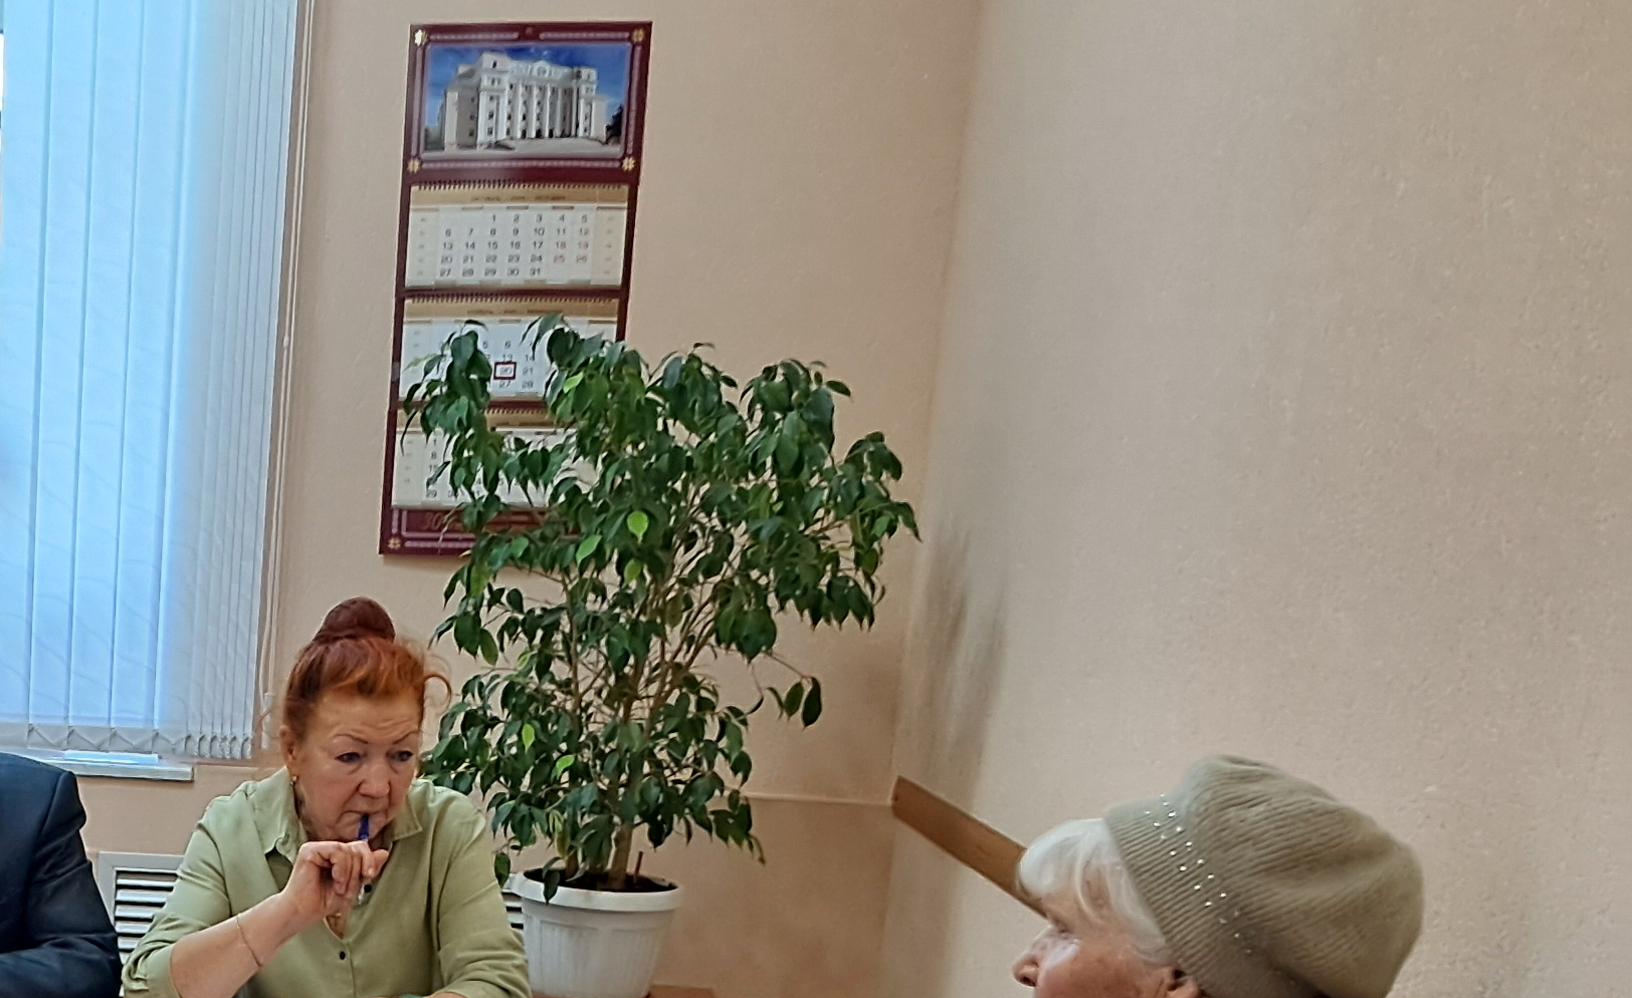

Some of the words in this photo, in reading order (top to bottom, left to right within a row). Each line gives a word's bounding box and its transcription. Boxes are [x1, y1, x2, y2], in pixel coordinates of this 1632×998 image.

[559, 214, 565, 222] 4
[533, 227, 546, 236] 10
[557, 227, 567, 236] 11
[578, 227, 589, 236] 12
[443, 241, 453, 250] 13
[465, 241, 476, 250] 14
[487, 241, 498, 250] 15
[510, 241, 521, 250] 16
[533, 240, 544, 249] 17
